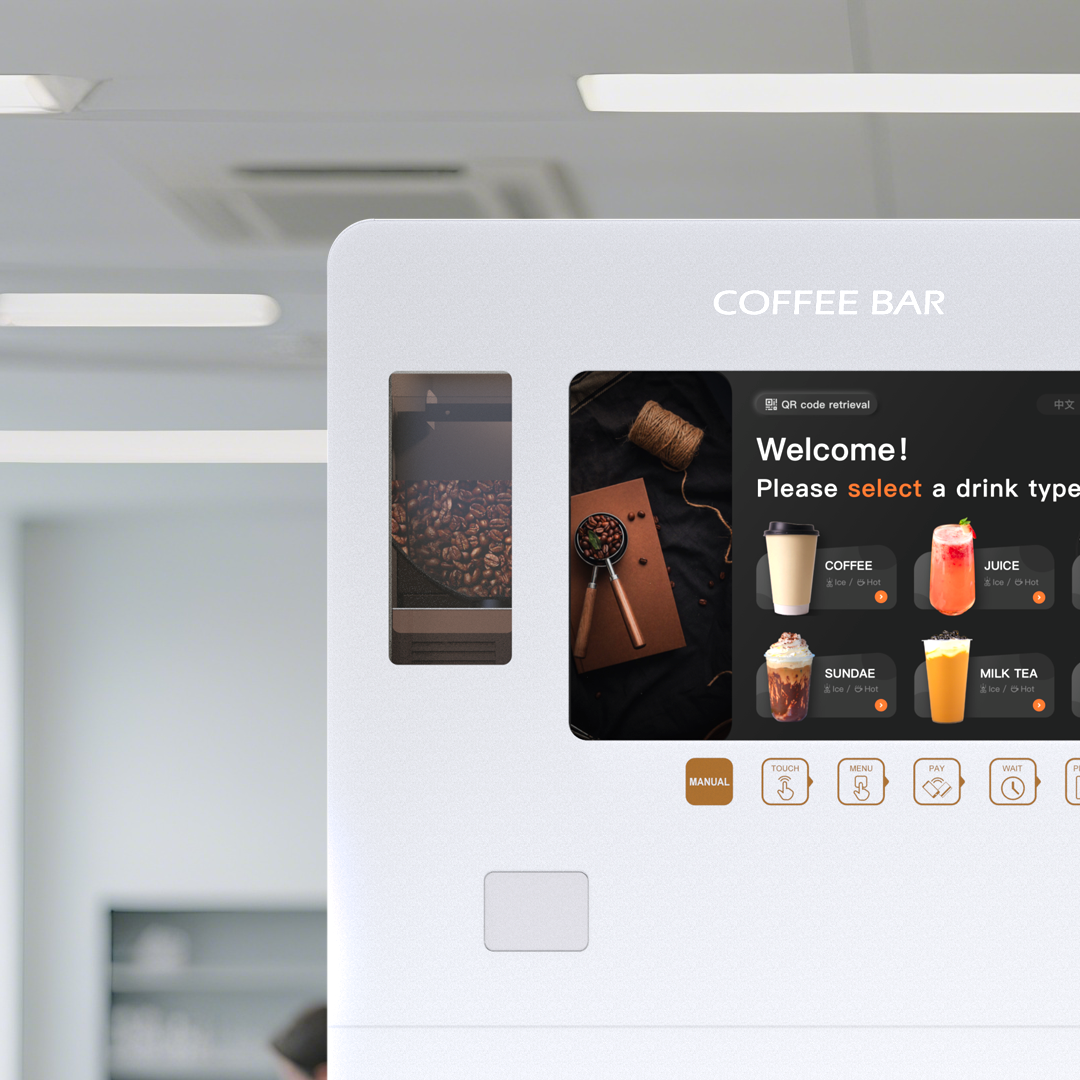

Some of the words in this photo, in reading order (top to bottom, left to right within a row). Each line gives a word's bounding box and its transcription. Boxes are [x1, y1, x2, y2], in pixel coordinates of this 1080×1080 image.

[714, 290, 858, 315] COFFEE
[872, 290, 944, 315] BAR
[781, 399, 798, 410] QR
[800, 399, 826, 410] code
[828, 399, 871, 410] retrieval
[1053, 398, 1075, 411] 中文
[756, 437, 906, 461] Welcome!
[758, 479, 837, 497] Please
[848, 479, 922, 497] select
[933, 483, 945, 497] a
[957, 479, 1018, 497] drink
[1028, 480, 1080, 502] type
[824, 560, 873, 571] COFFEE
[983, 560, 1020, 571] JUICE
[834, 578, 847, 587] Ice
[866, 578, 882, 587] Hot
[992, 578, 1005, 587] Ice
[1024, 578, 1039, 587] Hot
[824, 668, 876, 679] SUNDAE
[980, 668, 1011, 679] MILK
[1013, 668, 1038, 679] TEA
[832, 685, 845, 693] Ice
[864, 685, 879, 693] Hot
[988, 685, 1001, 693] Ice
[1020, 685, 1035, 693] Hot
[770, 764, 800, 773] TOUCH
[849, 764, 874, 773] MENU
[928, 764, 946, 773] PAY
[1001, 764, 1023, 772] WAIT
[689, 777, 731, 787] MANUAL
